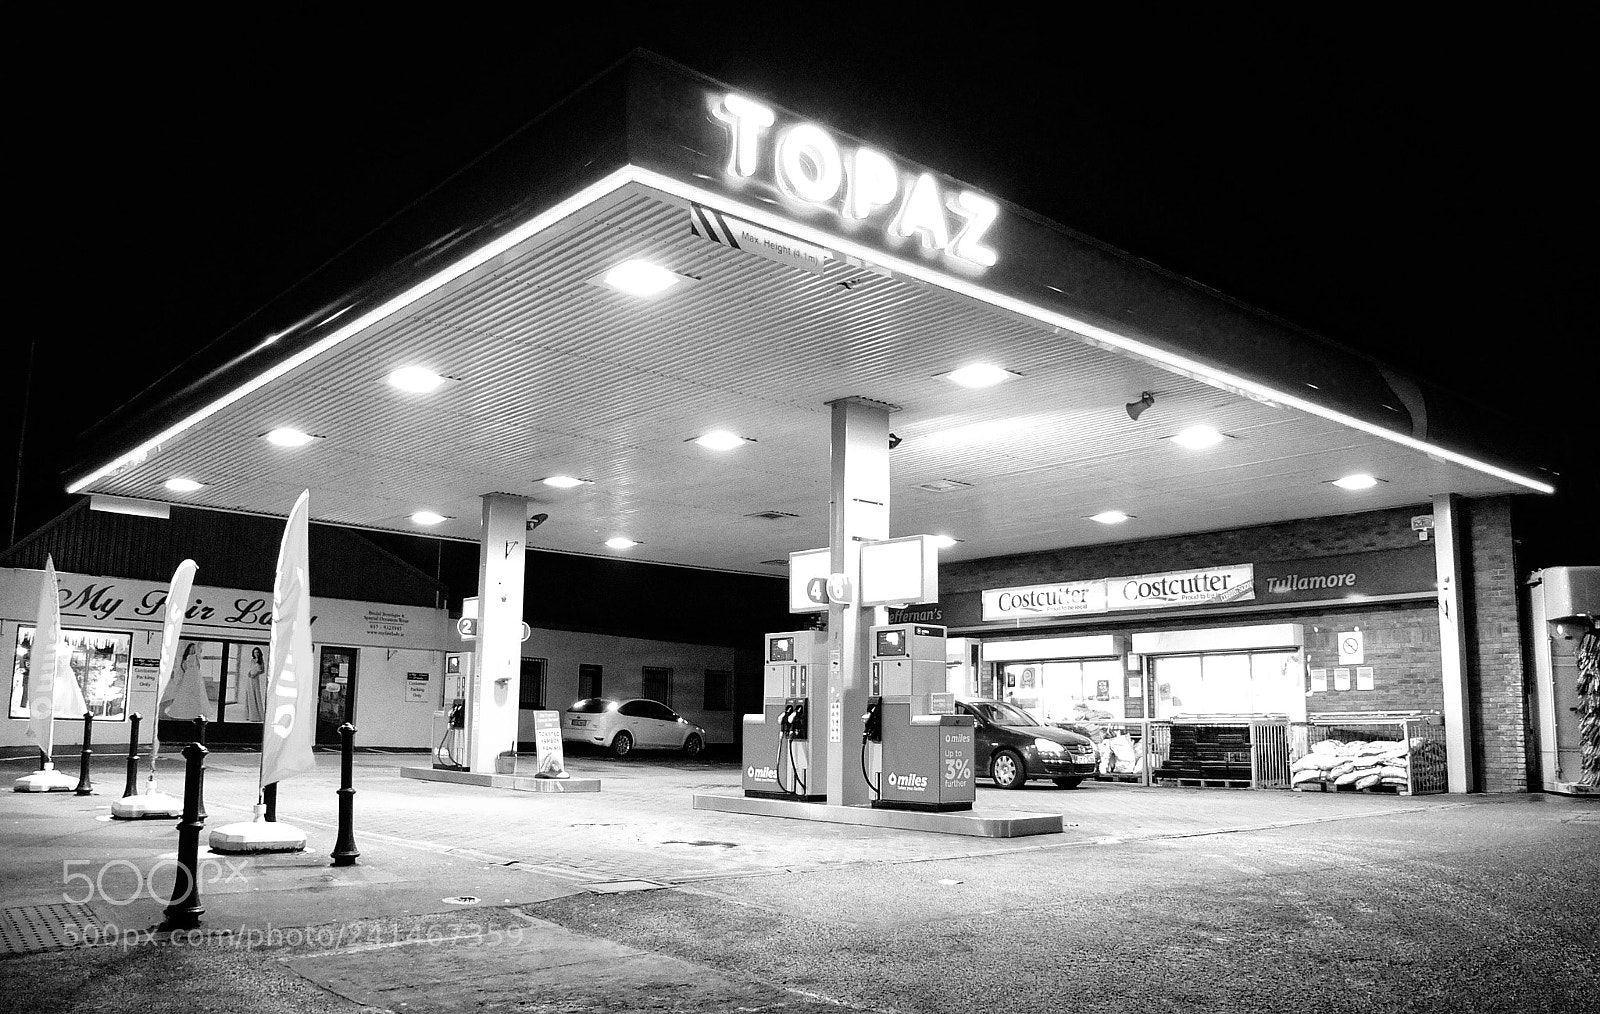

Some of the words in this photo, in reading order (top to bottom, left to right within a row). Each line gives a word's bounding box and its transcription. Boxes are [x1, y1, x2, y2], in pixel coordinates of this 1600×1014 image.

[706, 93, 1000, 270] TOPAZ
[763, 237, 791, 255] Height
[810, 579, 822, 601] 4
[1123, 573, 1232, 601] Costcutter
[1266, 573, 1356, 593] Tullamore
[57, 584, 124, 620] My
[134, 589, 215, 620] Fir
[998, 588, 1090, 612] Costcutter
[1181, 593, 1199, 601] Proud
[889, 607, 943, 624] effernan's
[461, 619, 473, 634] 2
[951, 734, 971, 743] miles
[944, 750, 954, 759] Up
[754, 765, 778, 780] miles
[944, 758, 971, 780] 3%
[897, 773, 928, 788] miles
[944, 779, 967, 788] further
